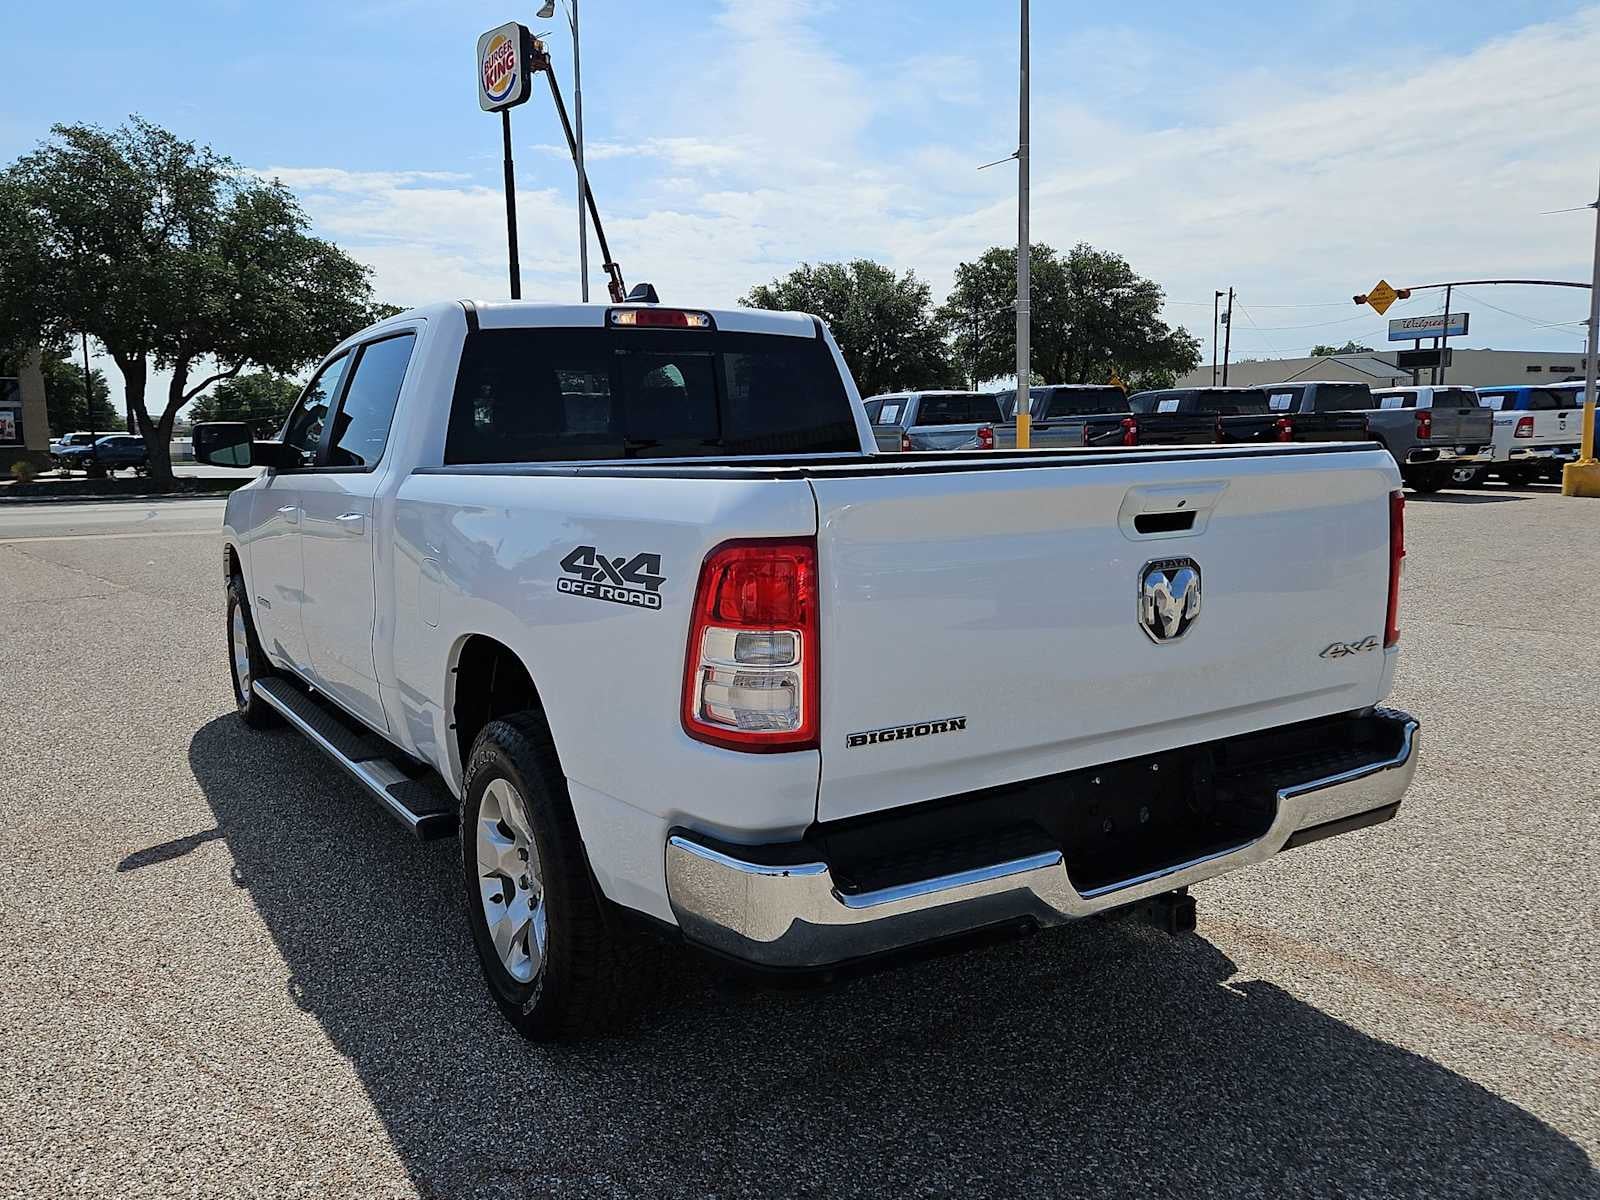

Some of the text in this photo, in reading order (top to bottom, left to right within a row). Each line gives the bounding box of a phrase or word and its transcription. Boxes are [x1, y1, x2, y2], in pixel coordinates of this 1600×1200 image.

[484, 39, 513, 75] BURGER
[486, 51, 515, 92] KING
[1401, 318, 1457, 330] Walgrees
[558, 579, 661, 608] OFF ROAD
[846, 716, 967, 748] BIGHORN
